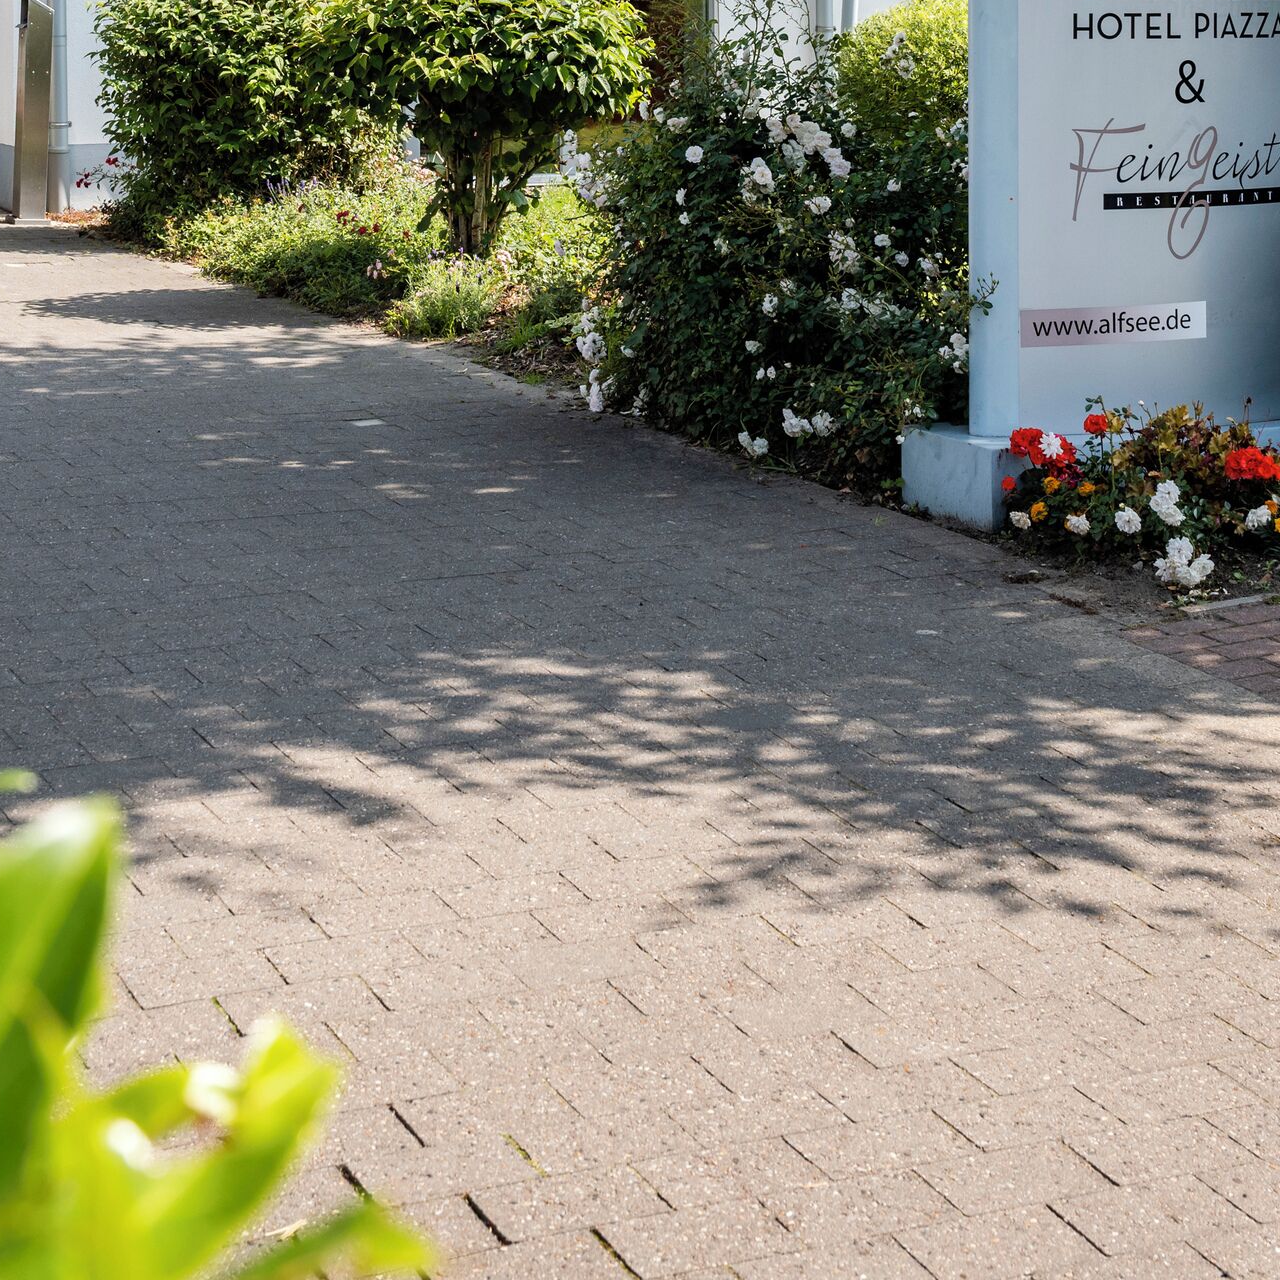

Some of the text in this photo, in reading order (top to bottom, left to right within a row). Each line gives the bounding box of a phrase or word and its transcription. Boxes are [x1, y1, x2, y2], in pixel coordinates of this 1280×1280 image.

[1072, 13, 1181, 40] HOTEL
[1174, 59, 1206, 105] &
[1116, 190, 1274, 207] RESTAURANT
[1032, 309, 1192, 338] www.alfsee.de
